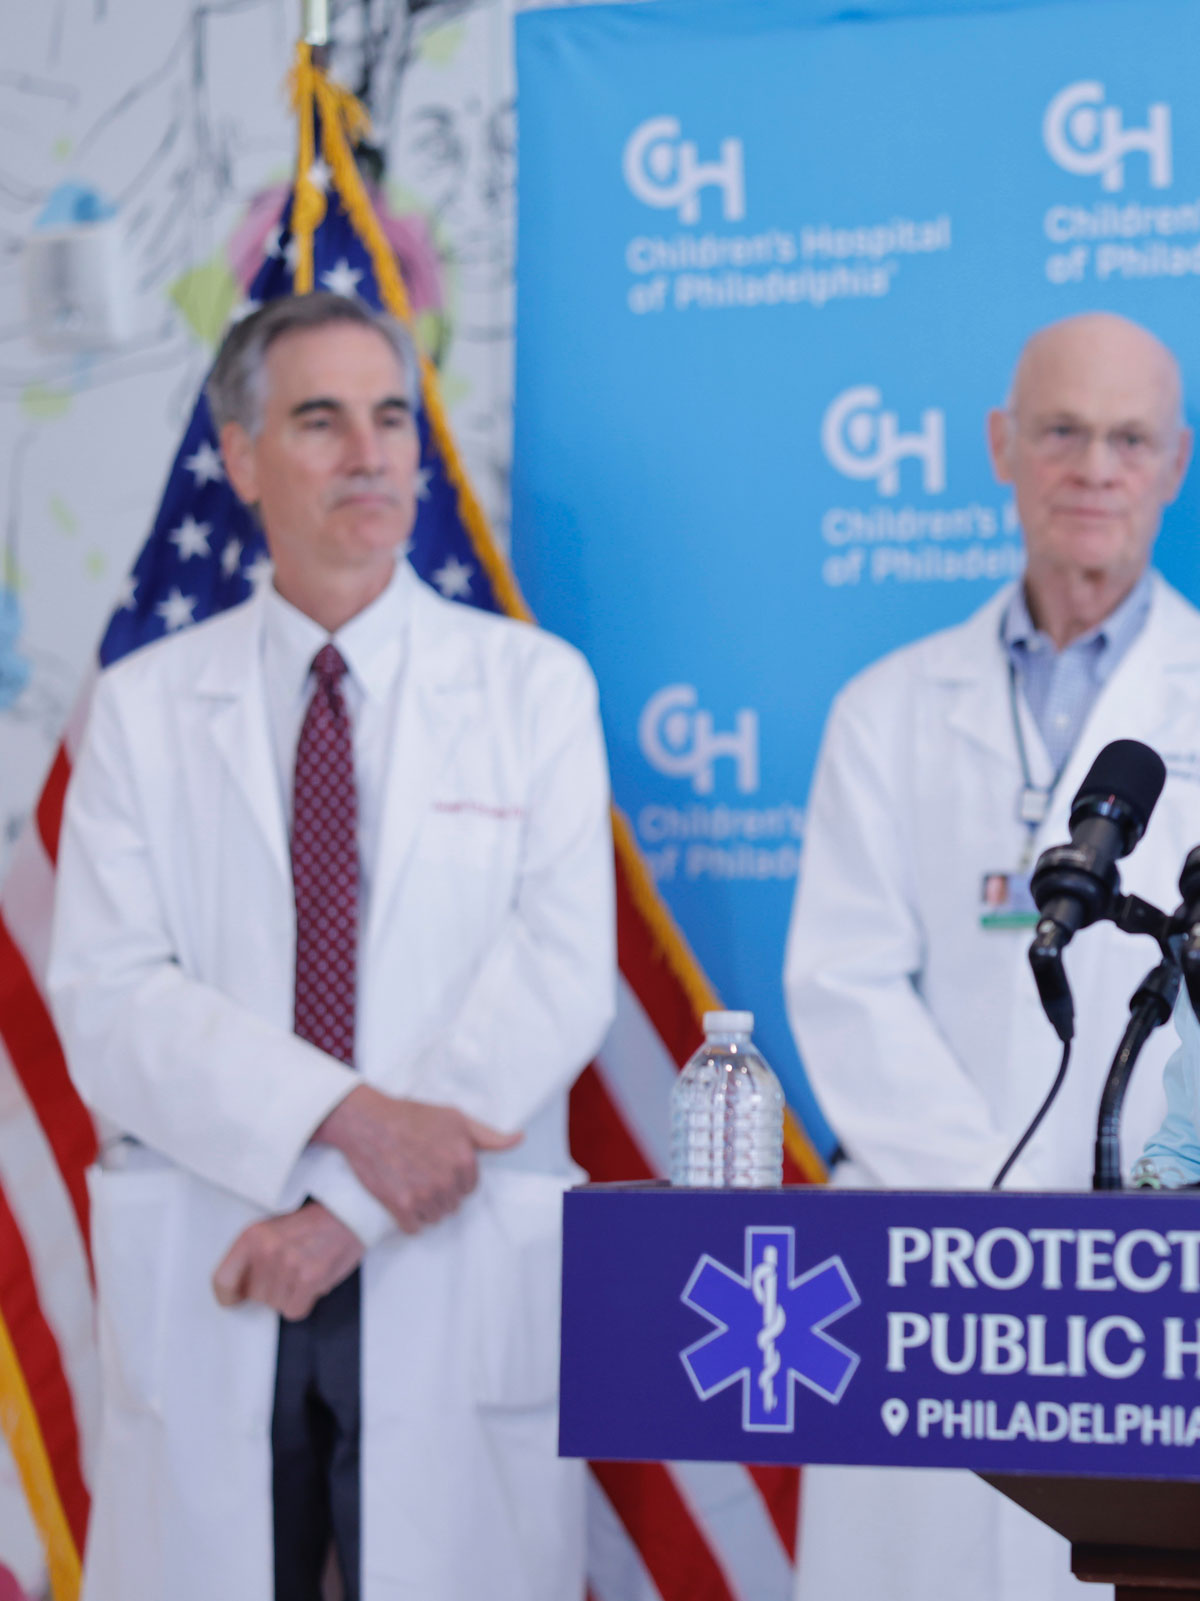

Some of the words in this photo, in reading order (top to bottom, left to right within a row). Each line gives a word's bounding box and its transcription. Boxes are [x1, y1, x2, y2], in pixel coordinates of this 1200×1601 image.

[626, 228, 797, 274] Children's
[801, 214, 952, 262] Hospital
[1045, 244, 1088, 283] of
[627, 274, 667, 314] of
[822, 503, 998, 545] Children's
[822, 548, 866, 587] of
[886, 1311, 1147, 1380] PUBLIC
